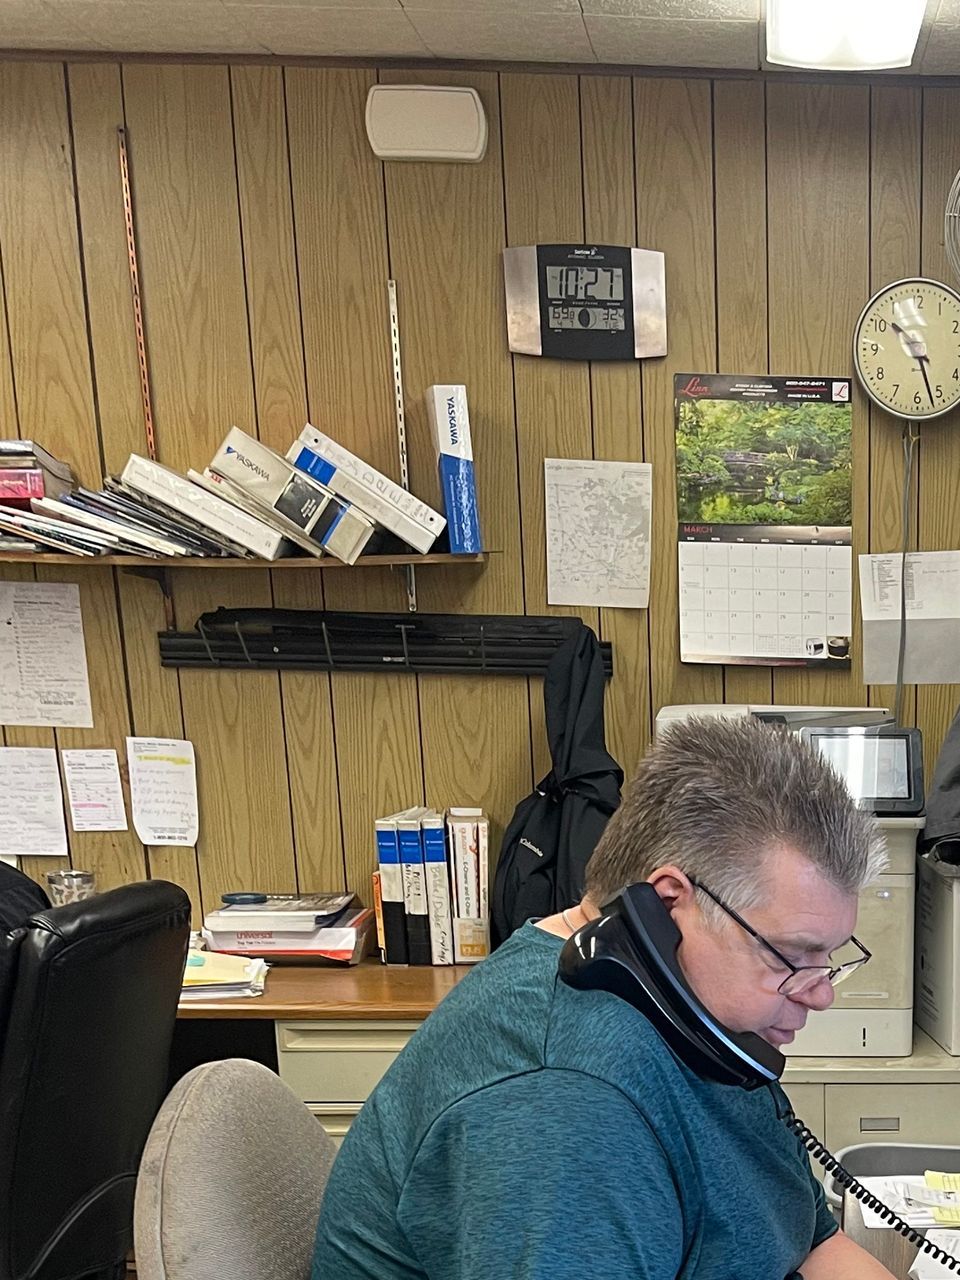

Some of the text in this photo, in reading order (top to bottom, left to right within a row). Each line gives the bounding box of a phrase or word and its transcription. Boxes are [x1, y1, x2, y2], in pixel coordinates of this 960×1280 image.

[913, 295, 924, 309] 12
[874, 319, 959, 334] 10 2
[870, 343, 879, 357] 9
[876, 367, 959, 381] 8 4
[892, 384, 943, 404] 7 6 5
[446, 396, 459, 447] YASKAWA
[234, 454, 271, 483] YASKAWA
[683, 526, 713, 534] MARCH
